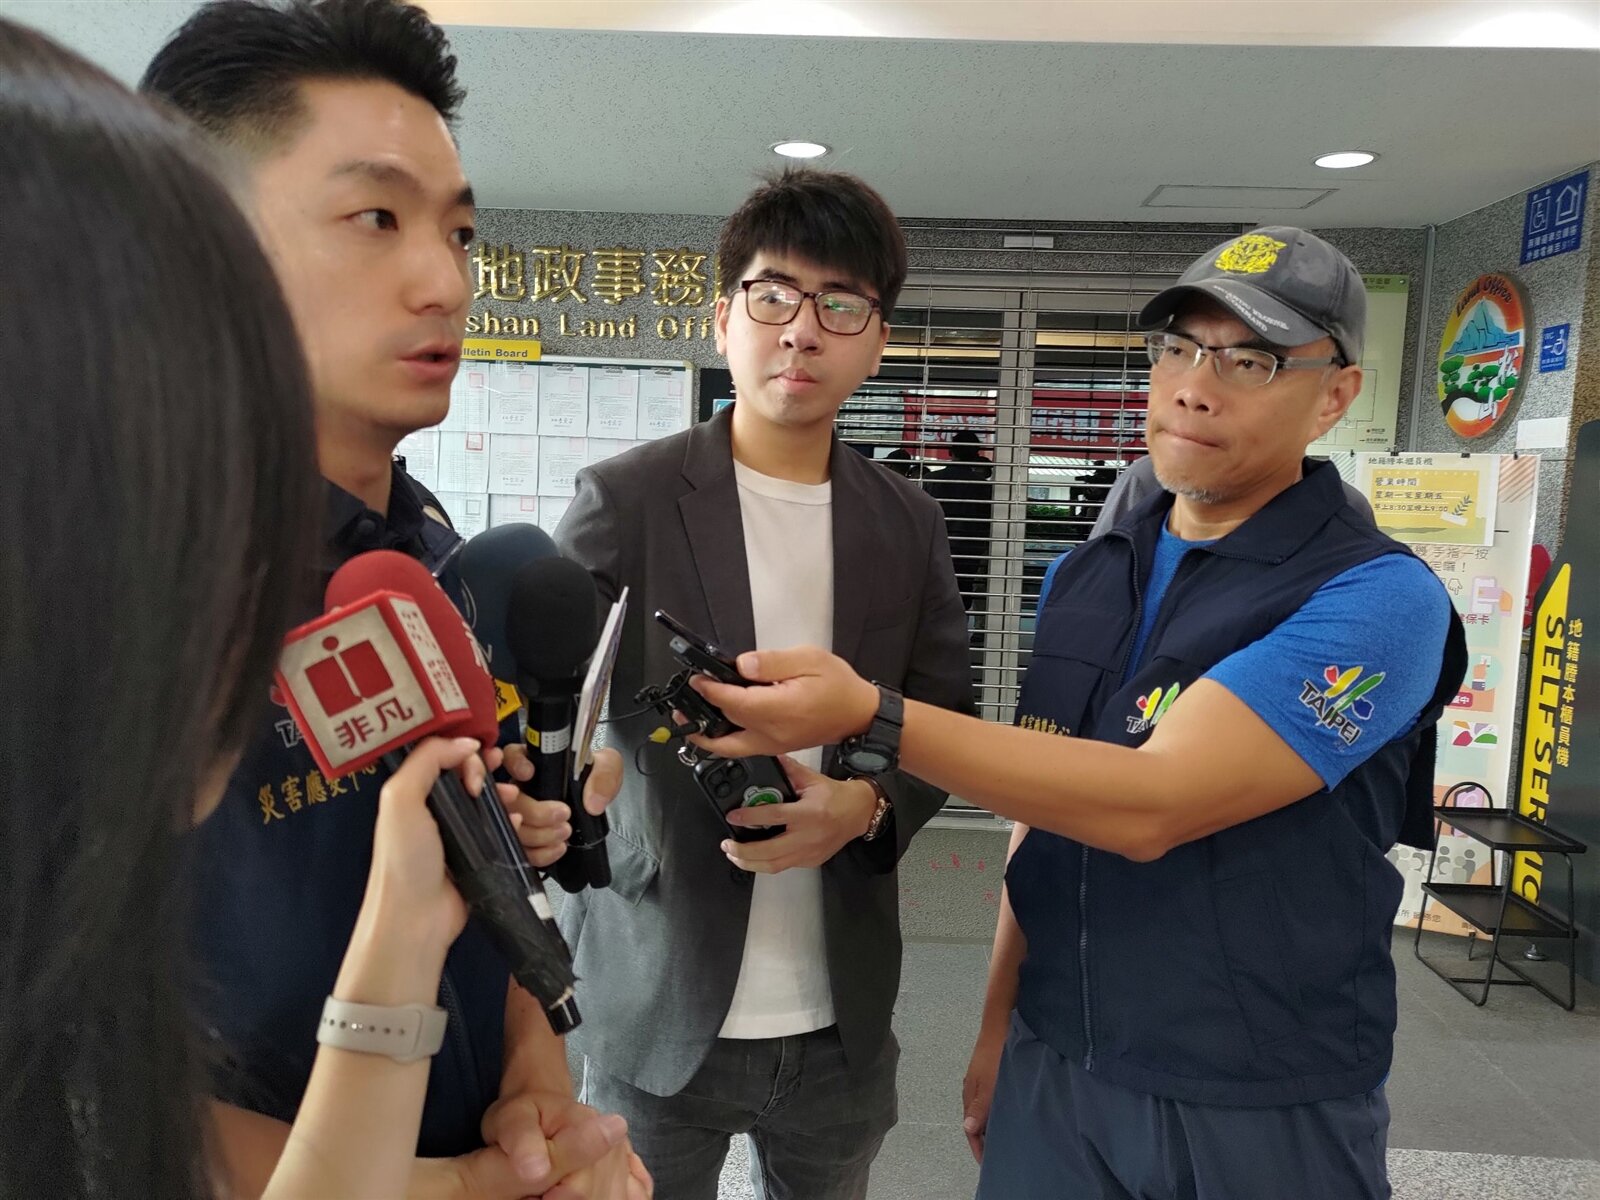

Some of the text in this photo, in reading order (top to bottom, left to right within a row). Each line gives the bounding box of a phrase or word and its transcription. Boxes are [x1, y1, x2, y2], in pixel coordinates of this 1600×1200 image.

[472, 242, 721, 308] 地政事務
[463, 347, 529, 358] lletin Board
[464, 310, 714, 341] shan Land Off
[1375, 490, 1443, 500] 星期一至星期五
[334, 696, 414, 750] 非凡
[1299, 679, 1362, 746] TAIPEI
[1556, 618, 1584, 768] 地籍謄本櫃員機
[1521, 614, 1565, 905] SELF SERIC
